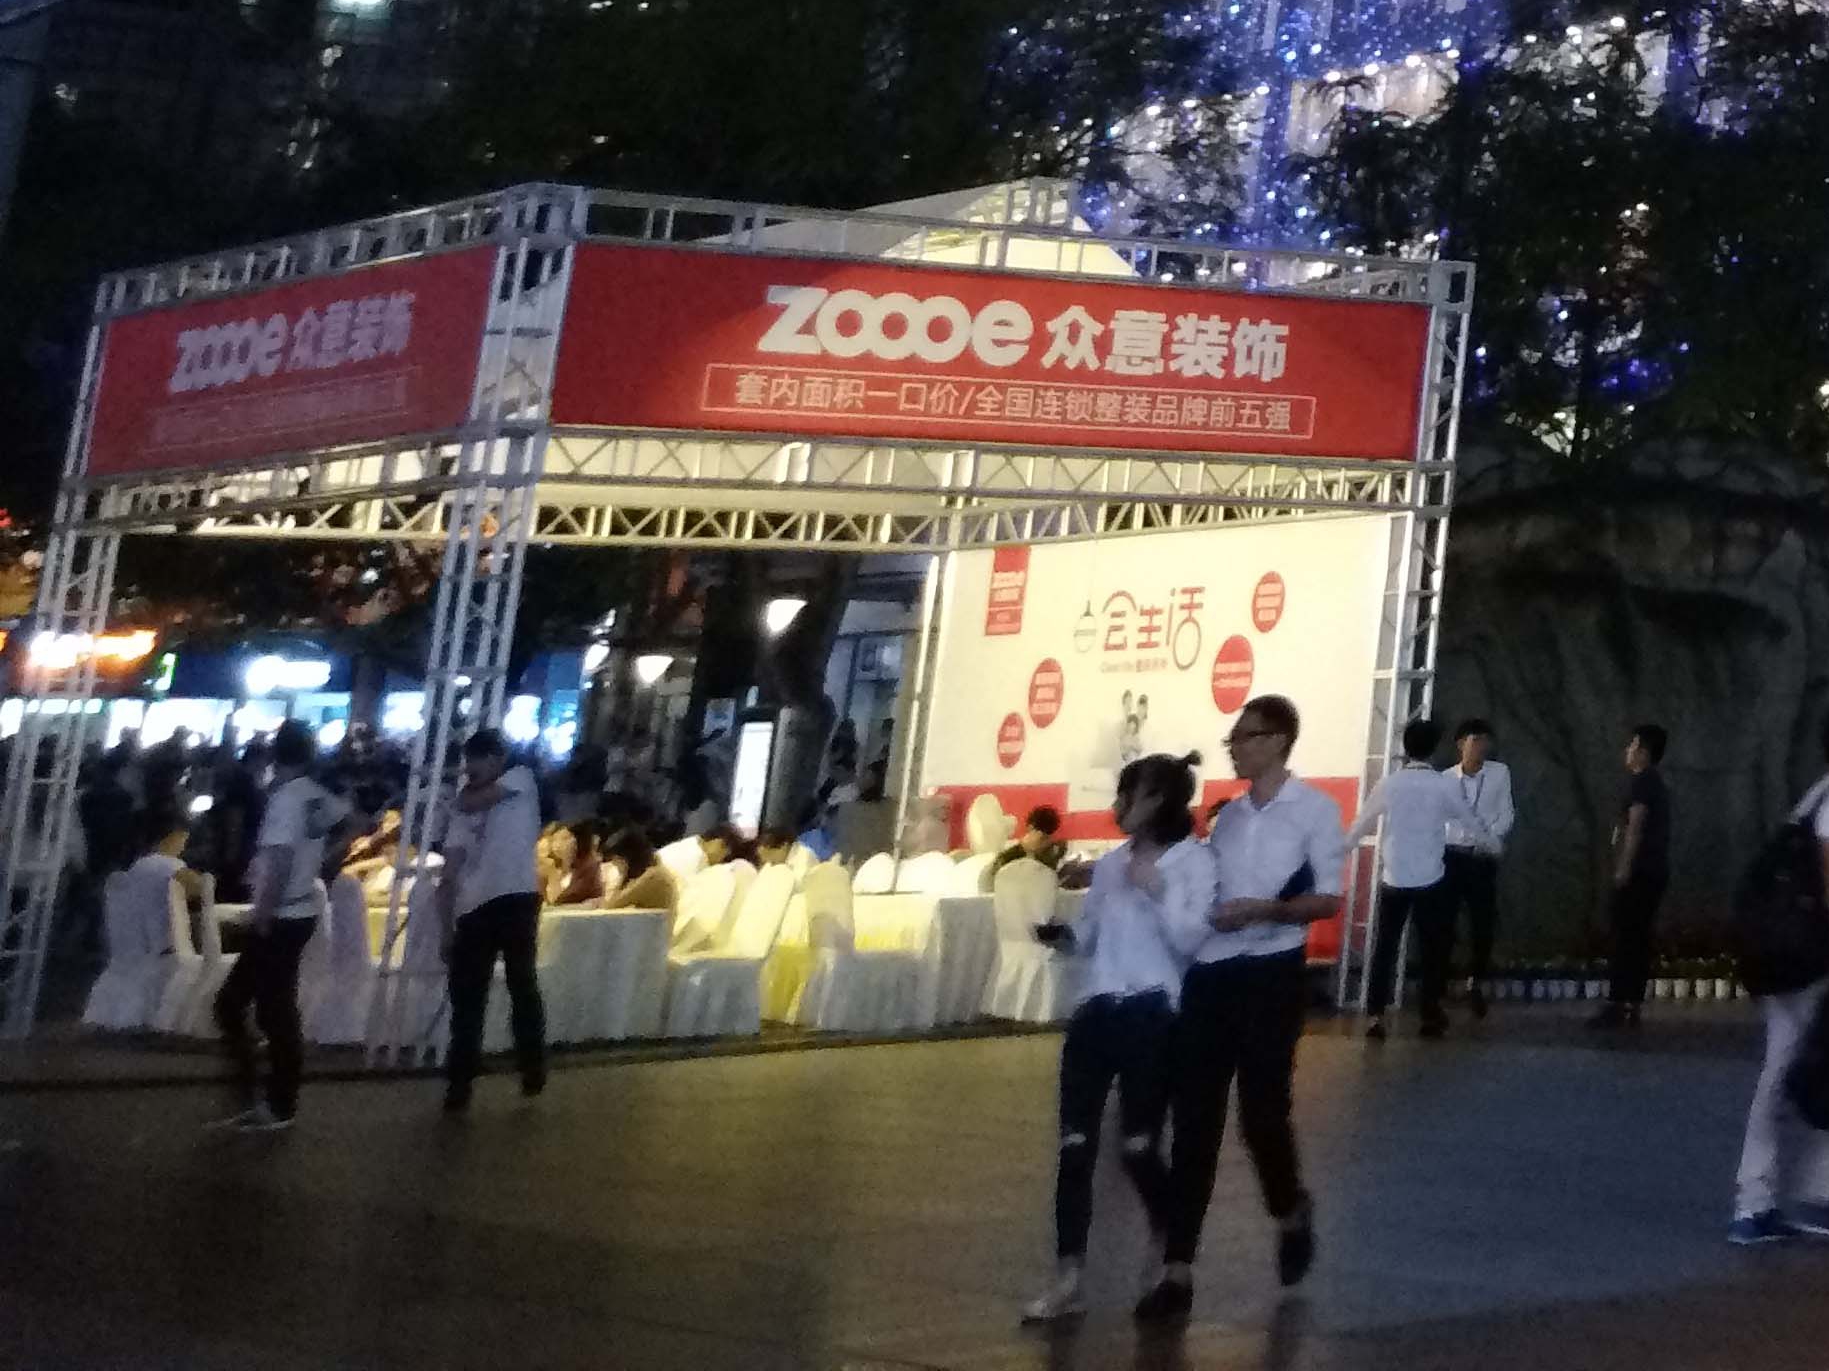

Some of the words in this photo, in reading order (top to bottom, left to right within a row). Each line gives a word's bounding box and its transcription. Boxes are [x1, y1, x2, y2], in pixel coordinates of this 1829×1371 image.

[1040, 305, 1291, 384] 众意装饰
[734, 371, 1292, 432] 套内面积一口价/全国连锁整装品牌前五强
